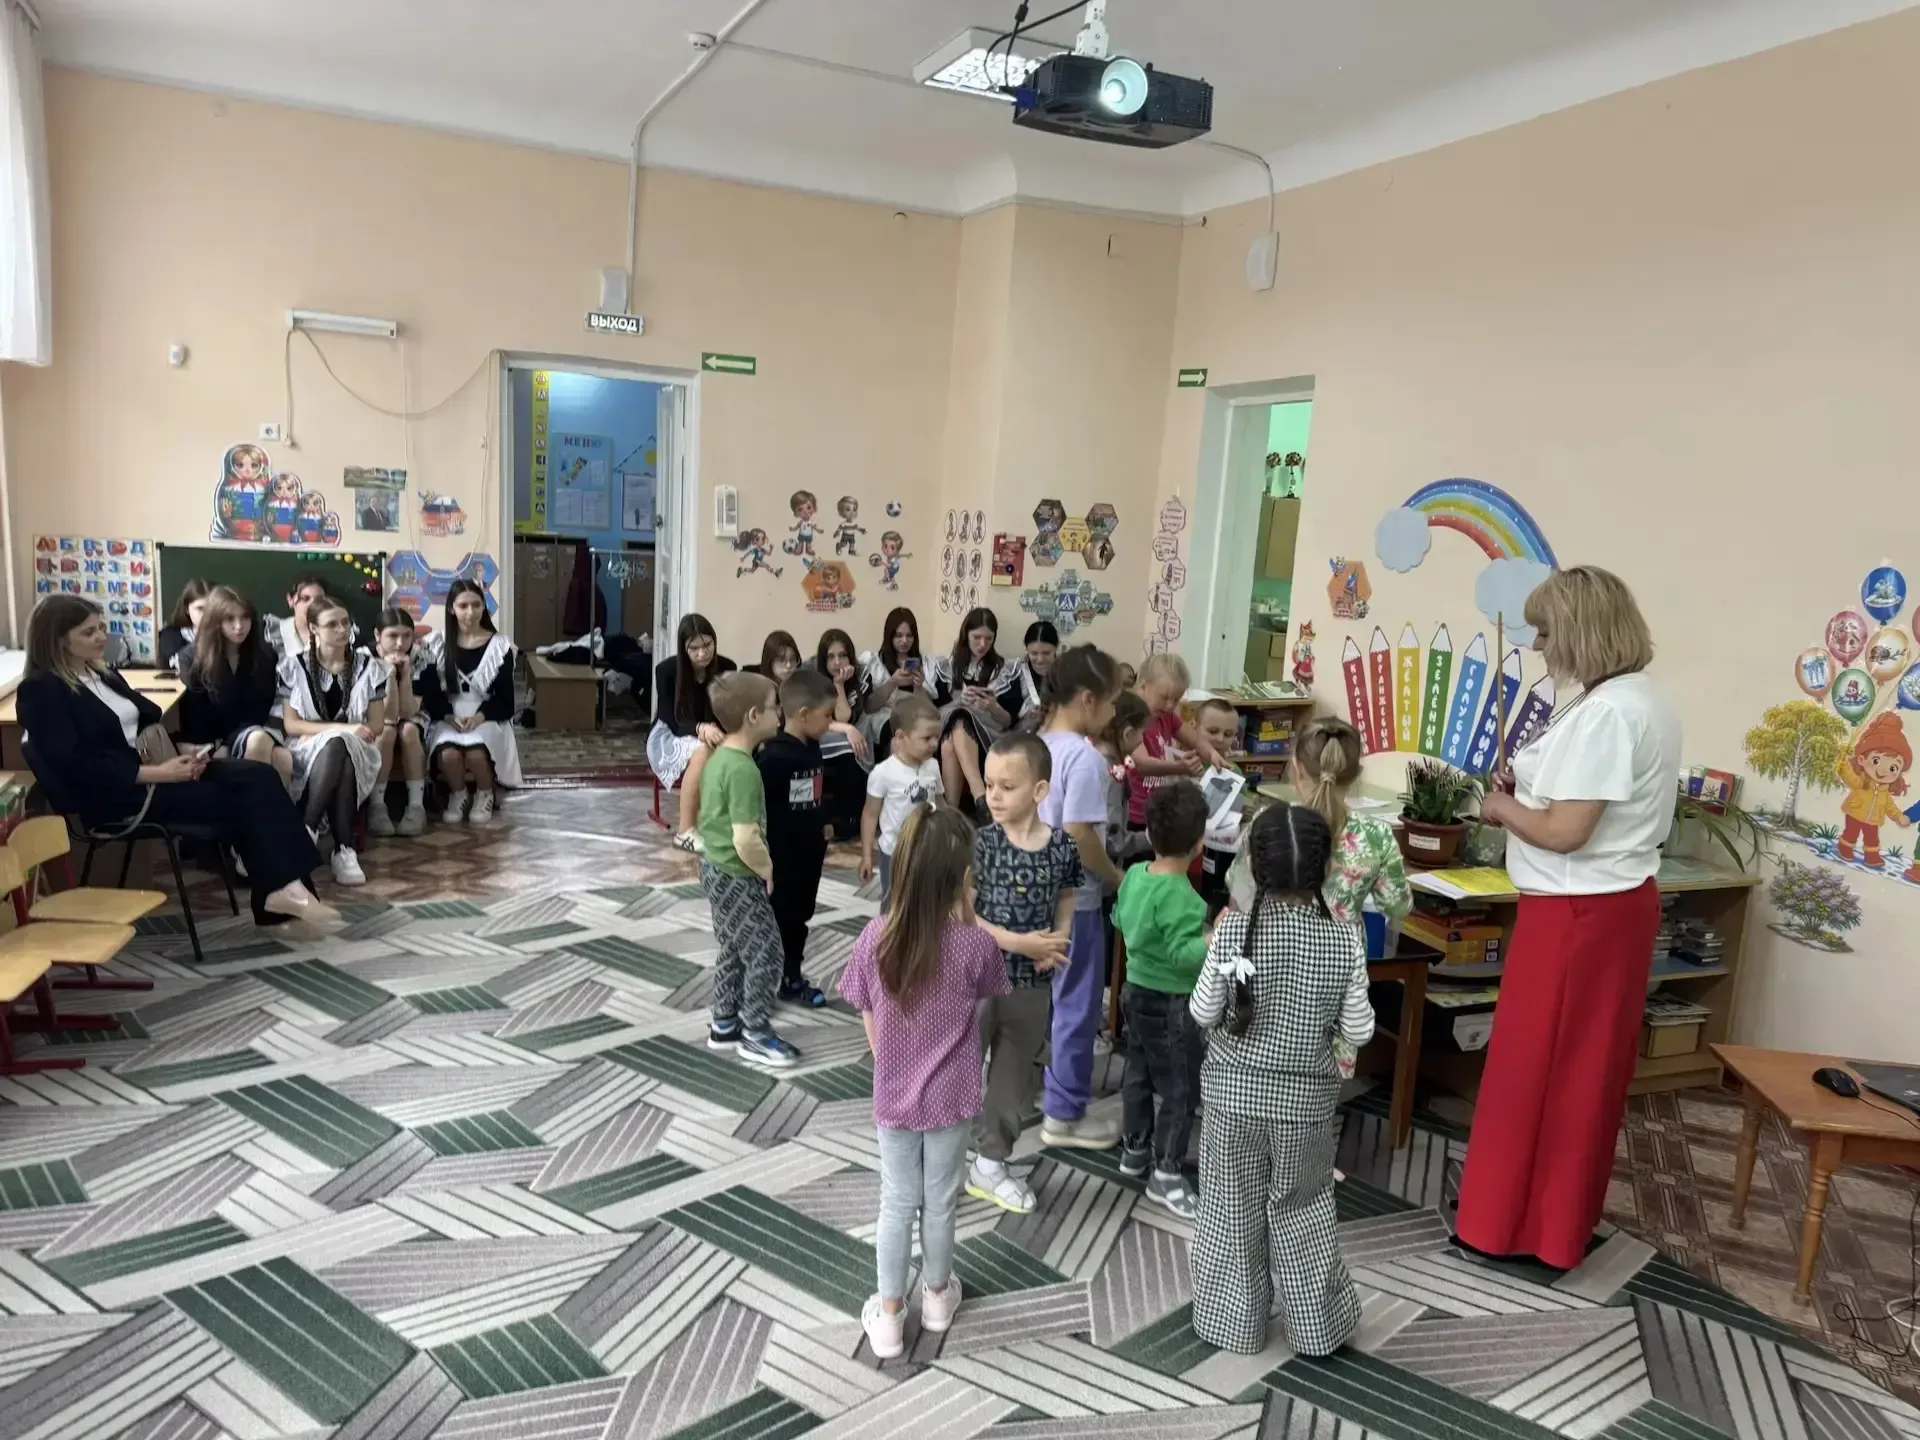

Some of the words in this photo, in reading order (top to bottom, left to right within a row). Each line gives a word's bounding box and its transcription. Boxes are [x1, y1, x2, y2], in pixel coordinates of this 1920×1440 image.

[590, 314, 638, 331] ВЫХОД
[1377, 654, 1389, 749] ОРАНЖЕВЫЙ
[1449, 664, 1477, 759] ГОЛУБОЙ
